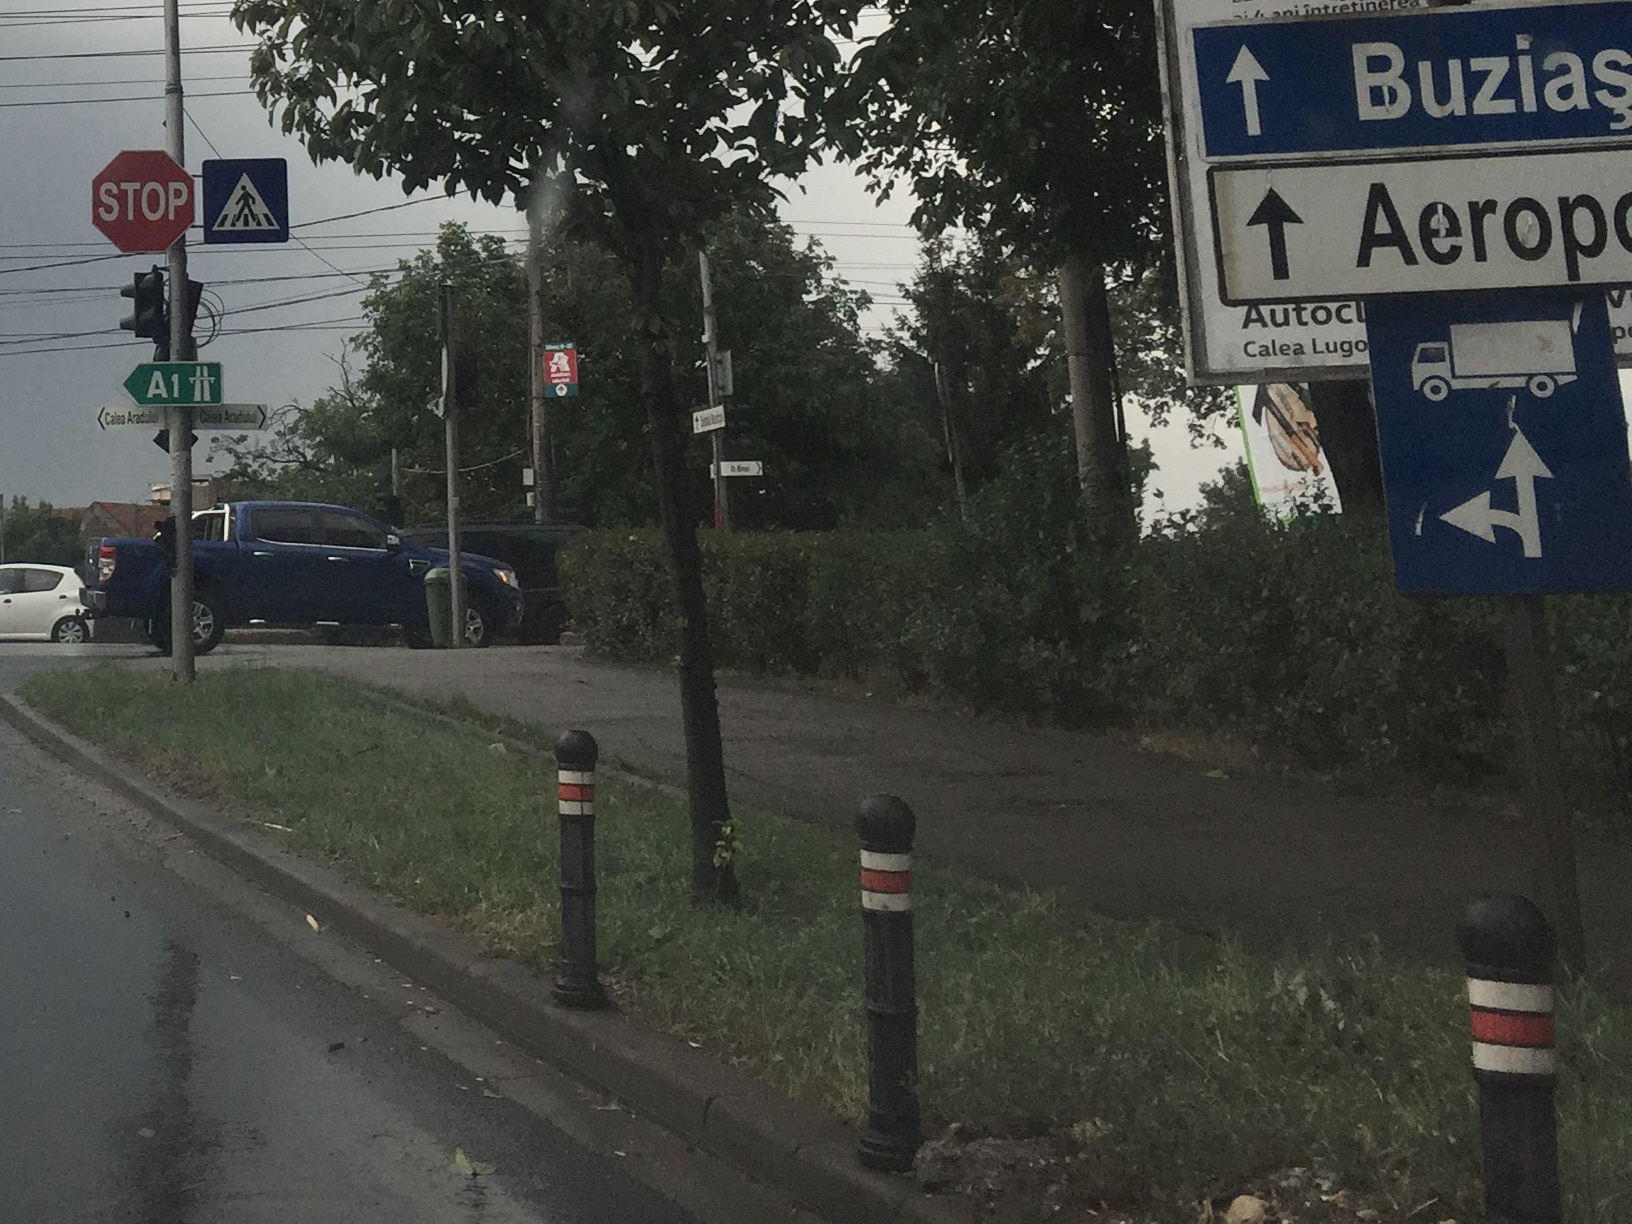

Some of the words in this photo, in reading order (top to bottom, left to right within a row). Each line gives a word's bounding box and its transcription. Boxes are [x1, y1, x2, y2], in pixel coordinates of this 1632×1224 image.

[98, 180, 189, 223] STOP
[1243, 339, 1307, 359] Calea
[146, 370, 180, 398] A1
